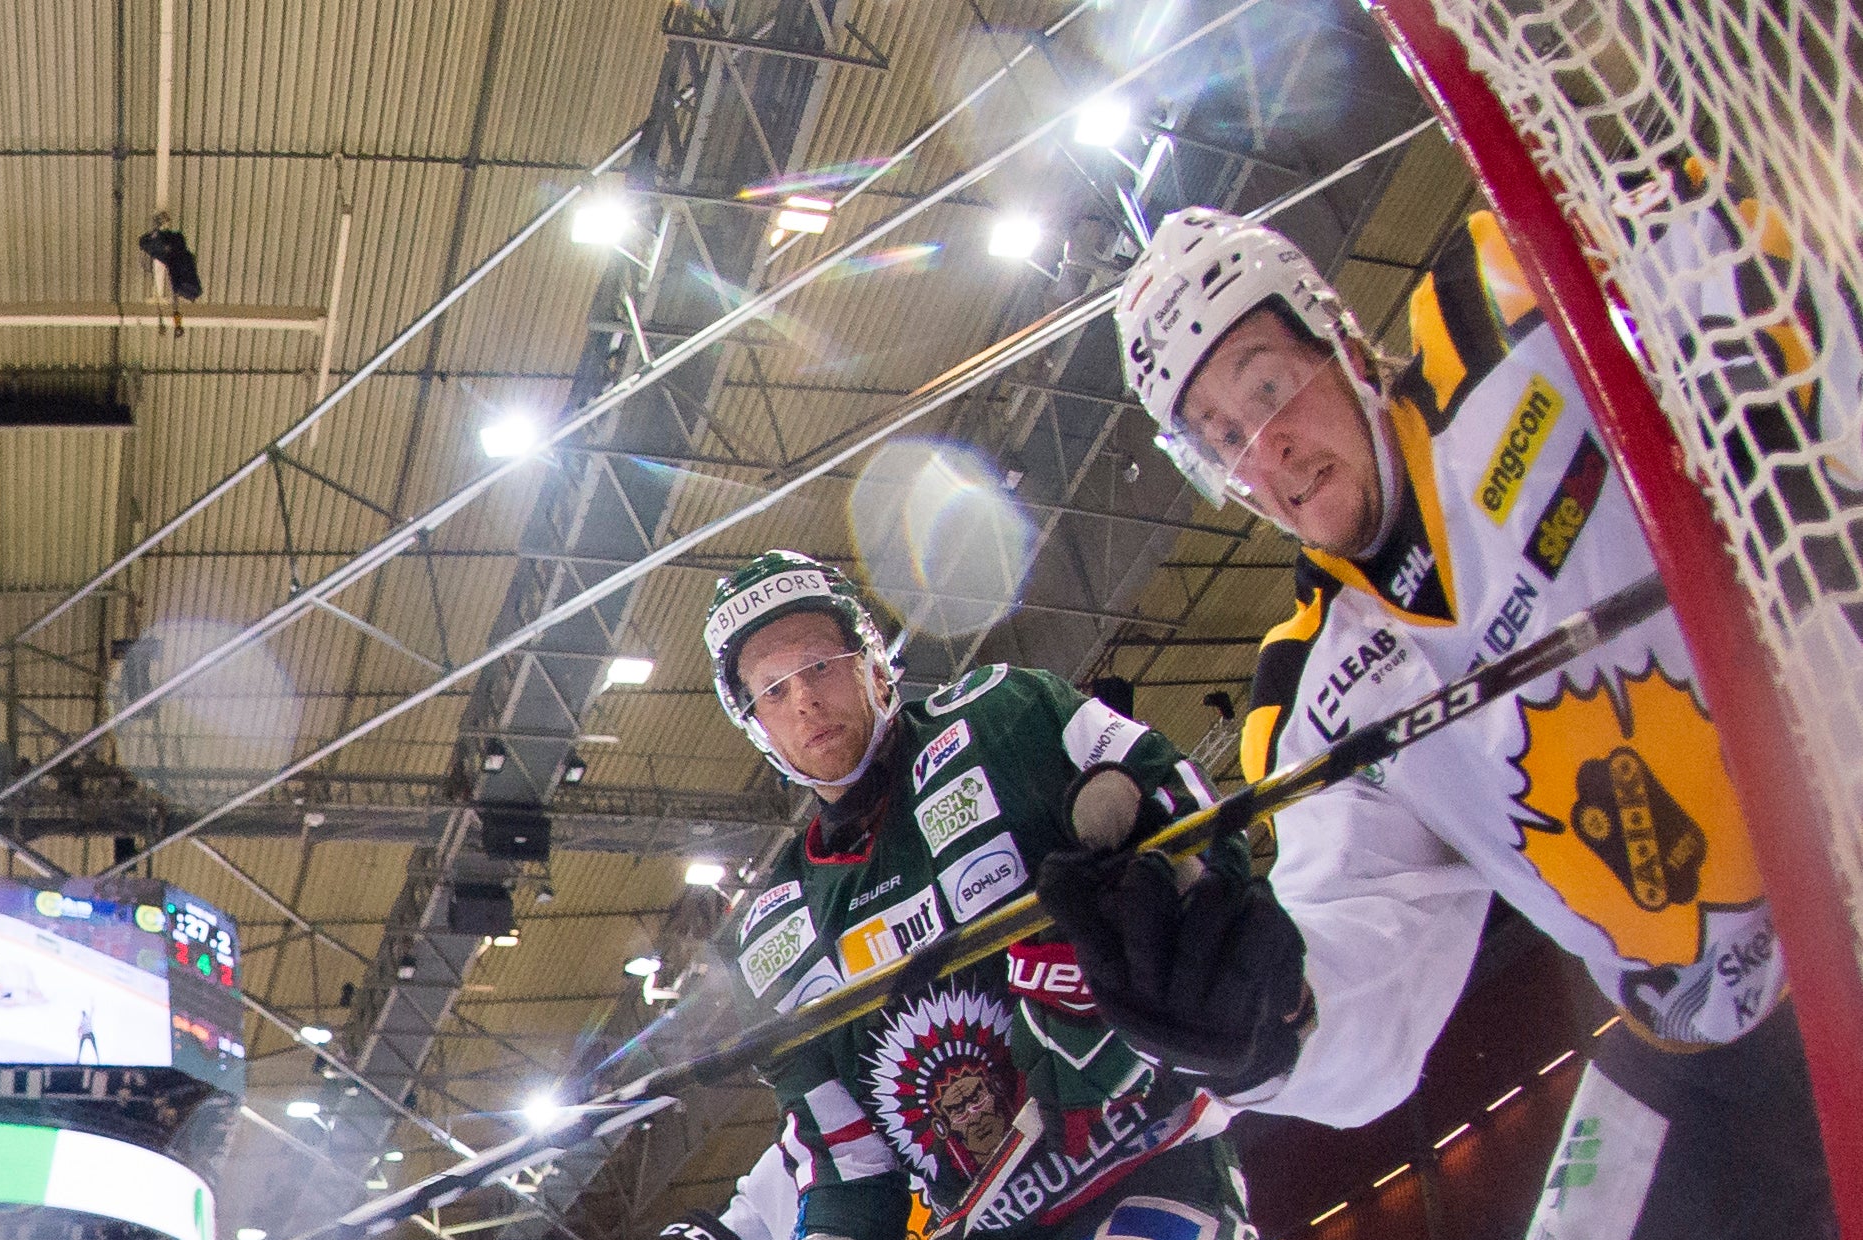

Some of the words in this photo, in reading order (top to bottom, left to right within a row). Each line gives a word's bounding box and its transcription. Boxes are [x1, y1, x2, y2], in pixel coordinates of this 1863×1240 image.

[1481, 390, 1553, 513] engcon
[1390, 545, 1436, 609] SHL
[717, 574, 820, 630] BJURFORS
[1328, 628, 1398, 697] LEAB
[1370, 649, 1408, 685] group
[927, 725, 959, 758] INTER
[932, 737, 961, 768] SPORT
[921, 791, 962, 830] CASH
[928, 802, 979, 849] BUDDY
[757, 884, 792, 909] INTER
[848, 874, 902, 912] BAUER
[961, 863, 1012, 902] BOHUS
[759, 893, 791, 917] SPORT
[747, 931, 788, 973] CASH
[863, 899, 937, 966] input
[751, 935, 801, 988] BUDDY
